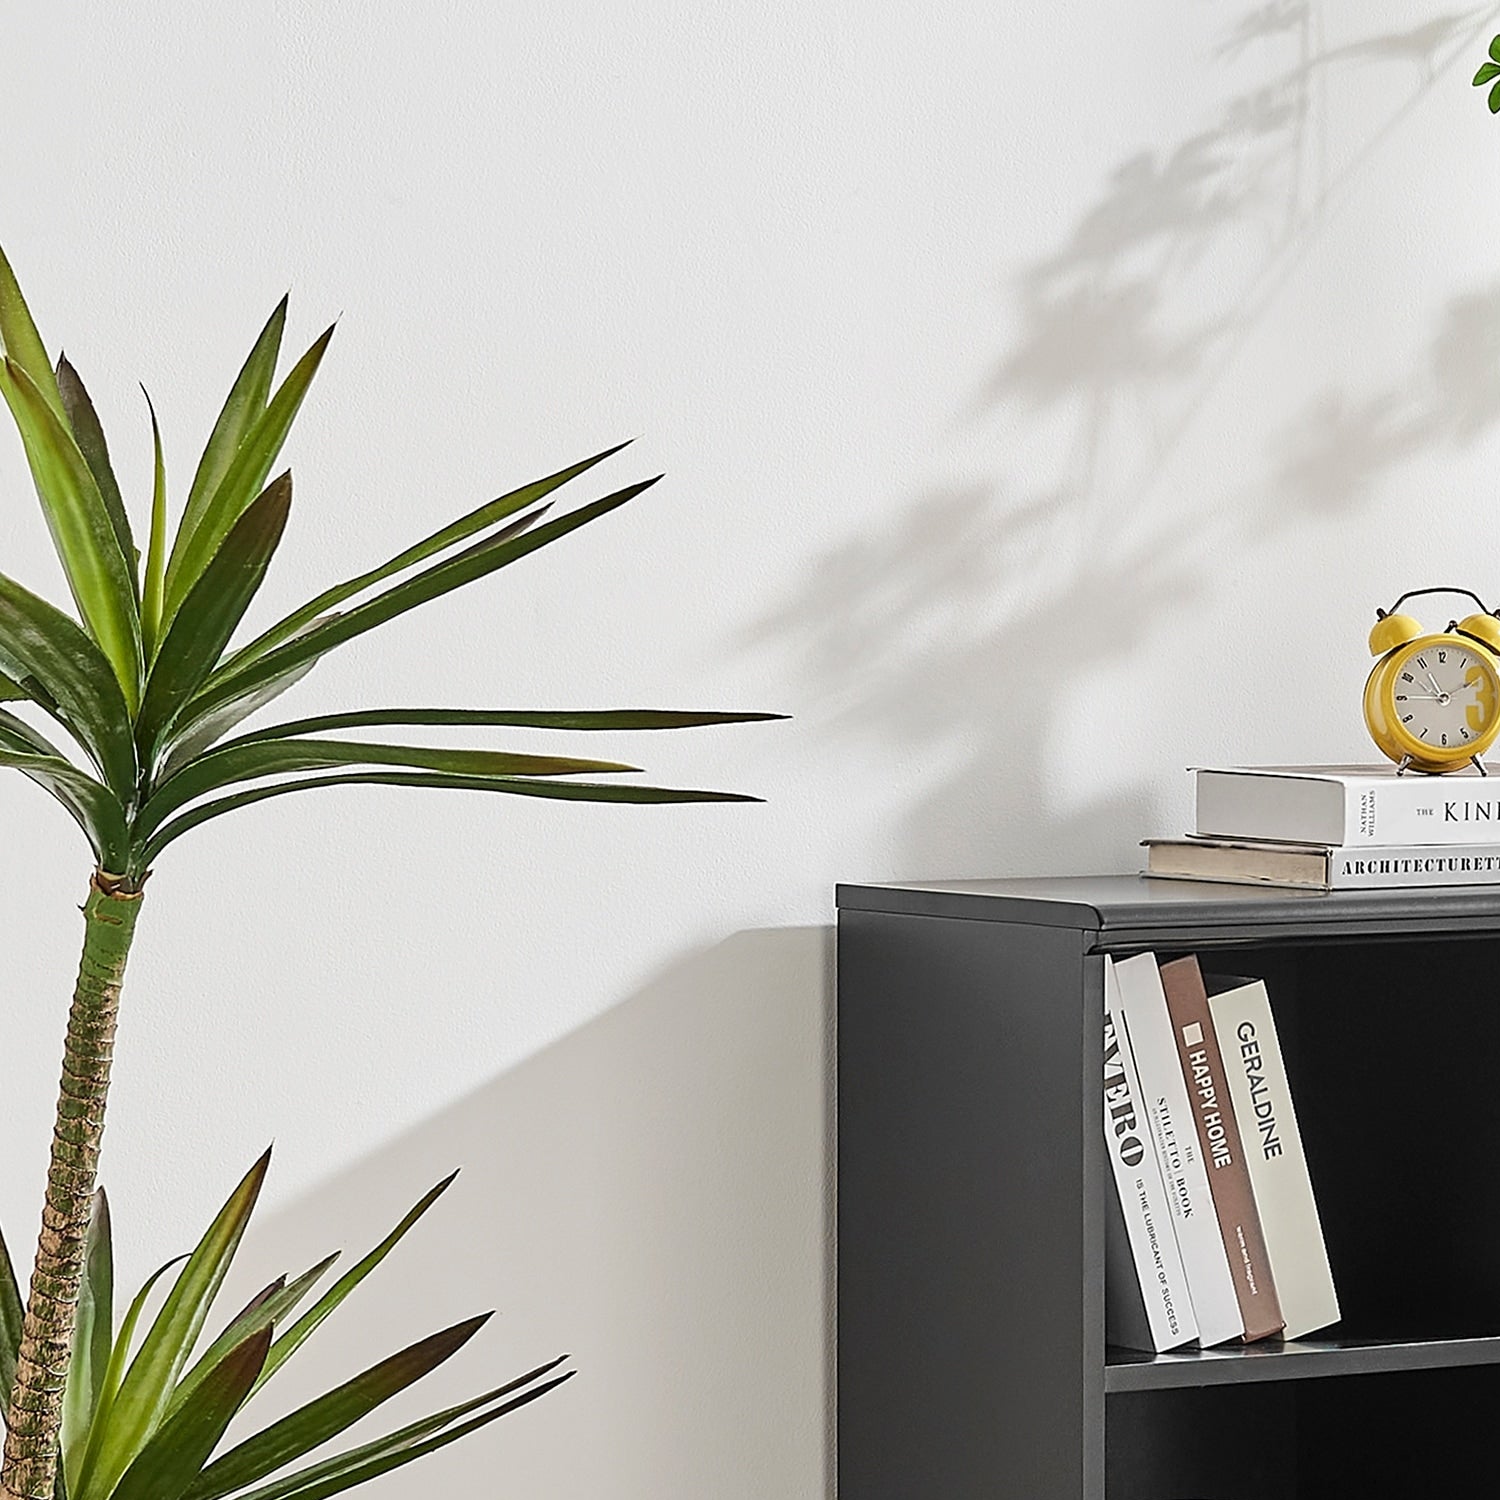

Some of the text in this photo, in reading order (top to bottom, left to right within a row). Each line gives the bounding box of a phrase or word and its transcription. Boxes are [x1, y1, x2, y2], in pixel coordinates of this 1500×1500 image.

[1417, 657, 1428, 669] 11
[1439, 651, 1447, 663] 12
[1460, 658, 1467, 668] 1
[1401, 672, 1414, 683] 10
[1465, 665, 1496, 732] 3
[1402, 714, 1414, 723] 8
[1420, 728, 1428, 738] 7
[1441, 733, 1447, 745] 6
[1460, 727, 1469, 739] 5
[1368, 790, 1376, 837] WILLIAMS
[1416, 808, 1434, 816] THE
[1237, 1021, 1283, 1160] GERALDINE
[1189, 1049, 1232, 1169] HAPPY HOME
[1157, 1097, 1181, 1169] STILETTO
[1176, 1177, 1194, 1219] BOOK
[1185, 1145, 1195, 1163] THE
[1139, 1190, 1150, 1212] THE
[1144, 1212, 1164, 1269] LUBRICANT
[1158, 1271, 1168, 1285] OF
[1161, 1287, 1180, 1335] SUCCESS
